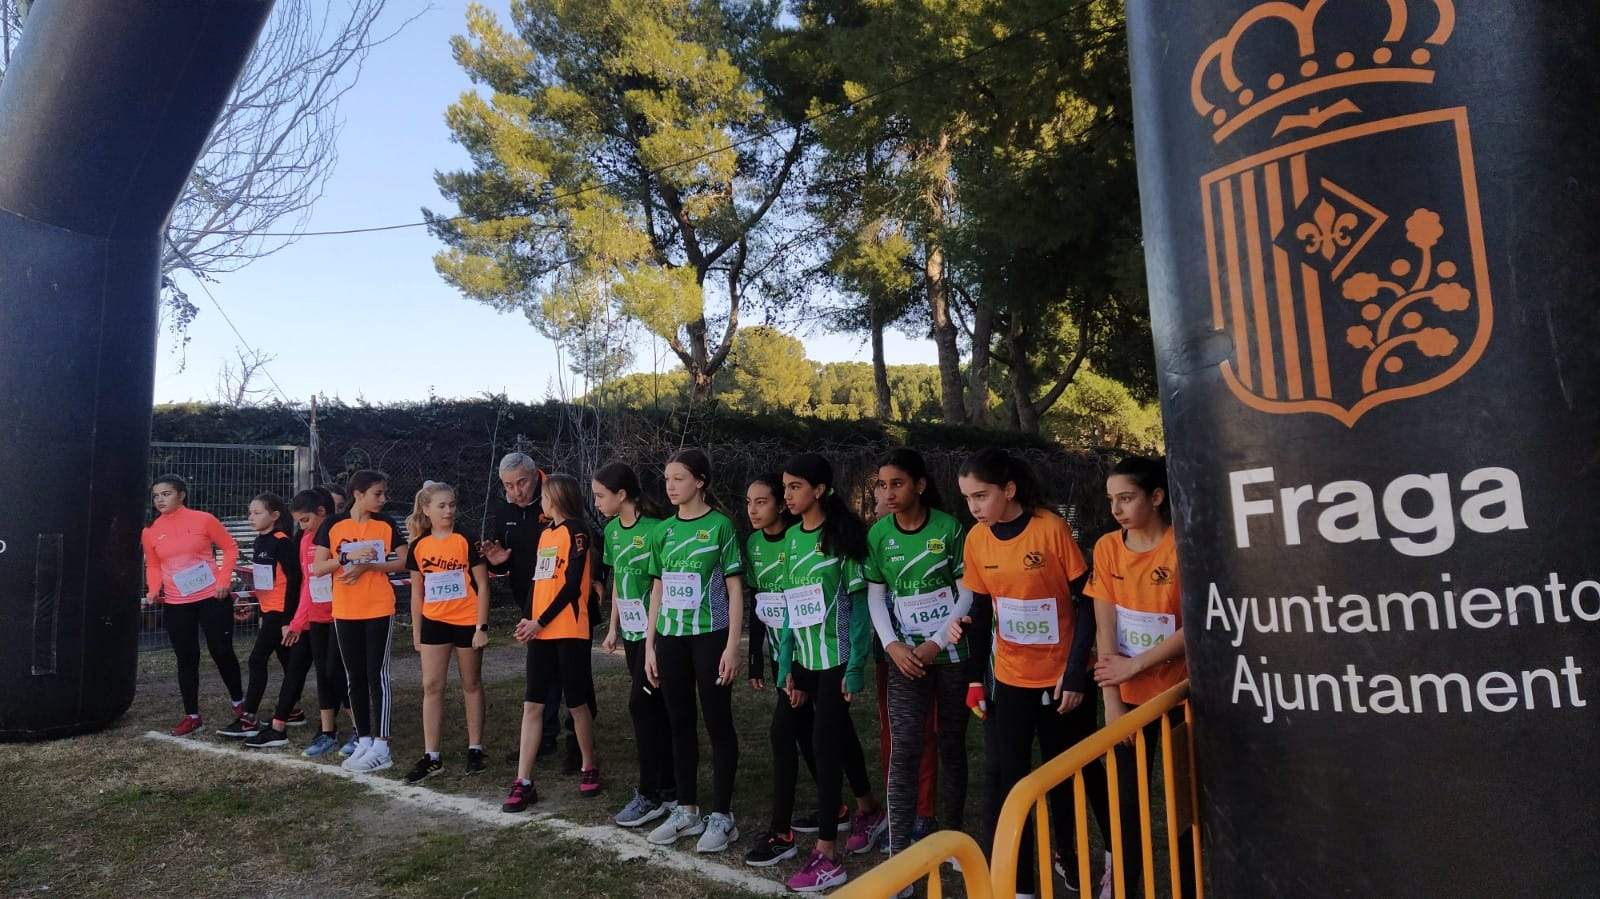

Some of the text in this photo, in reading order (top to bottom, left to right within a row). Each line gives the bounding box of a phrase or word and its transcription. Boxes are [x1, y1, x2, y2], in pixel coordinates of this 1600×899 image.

[1229, 467, 1528, 556] Fraga
[430, 584, 460, 595] 1758
[666, 586, 694, 598] 1849
[760, 606, 786, 618] 1857
[794, 601, 821, 617] 1864
[910, 605, 950, 624] 1842
[1207, 573, 1600, 647] Ayuntamiento
[1006, 619, 1050, 635] 1695
[1120, 628, 1165, 647] 1694
[1233, 655, 1586, 723] Ajuntament
